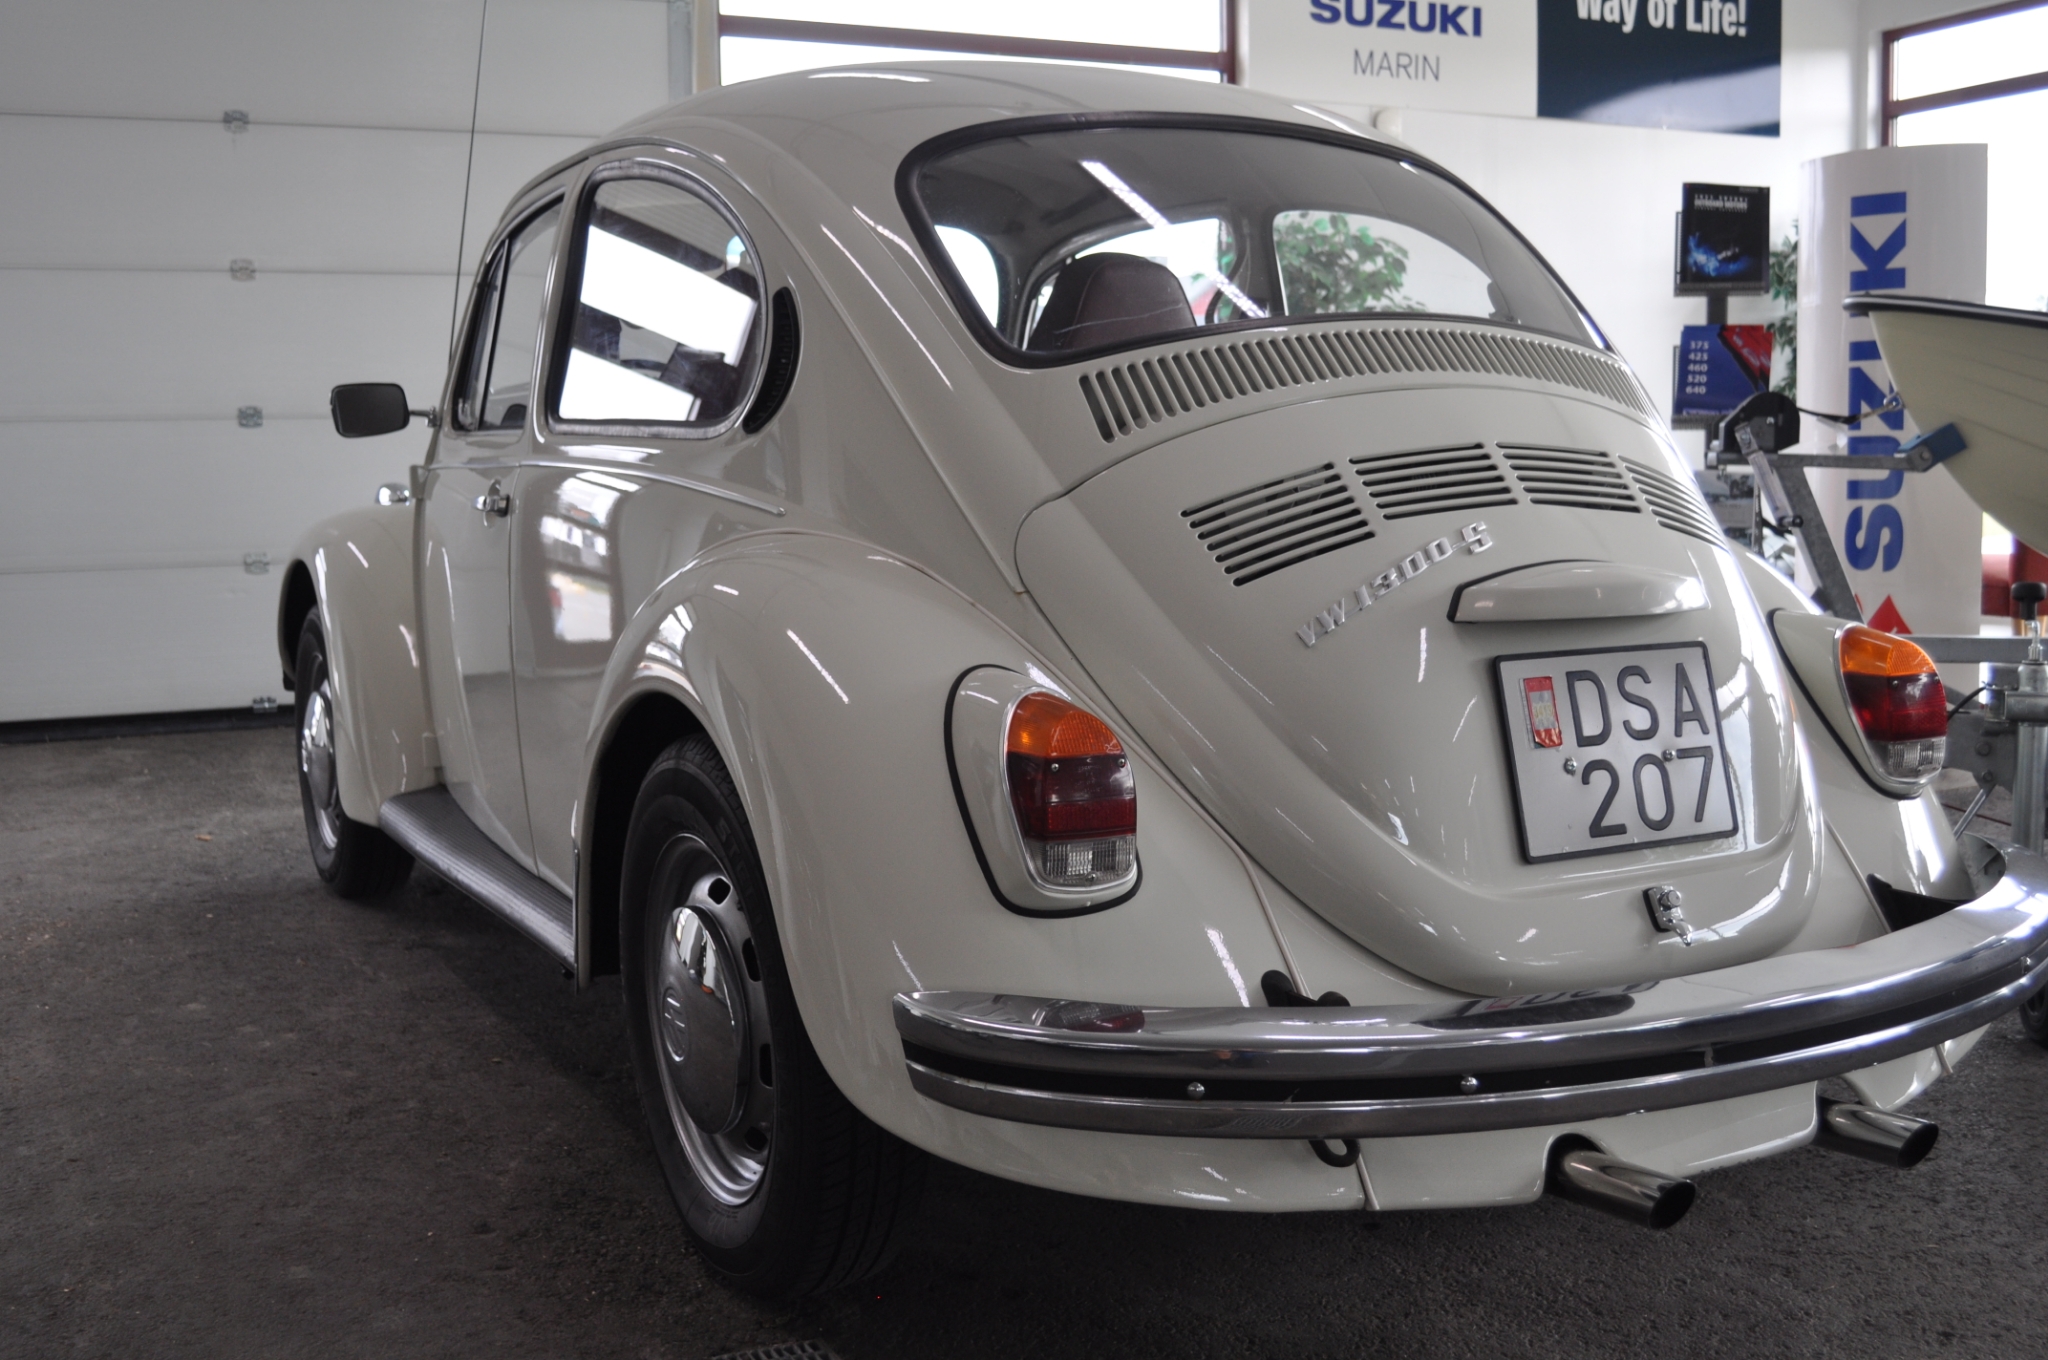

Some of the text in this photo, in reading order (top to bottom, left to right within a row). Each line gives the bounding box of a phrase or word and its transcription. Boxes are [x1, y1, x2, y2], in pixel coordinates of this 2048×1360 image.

[1310, 0, 1482, 37] SUZUKI
[1647, 0, 1677, 29] of
[1686, 0, 1747, 37] Life!
[1353, 49, 1440, 81] MARIN
[1687, 363, 1708, 373] 460
[1845, 191, 1907, 572] SUZKI
[1566, 663, 1710, 748] DSA
[1582, 745, 1714, 838] 207
